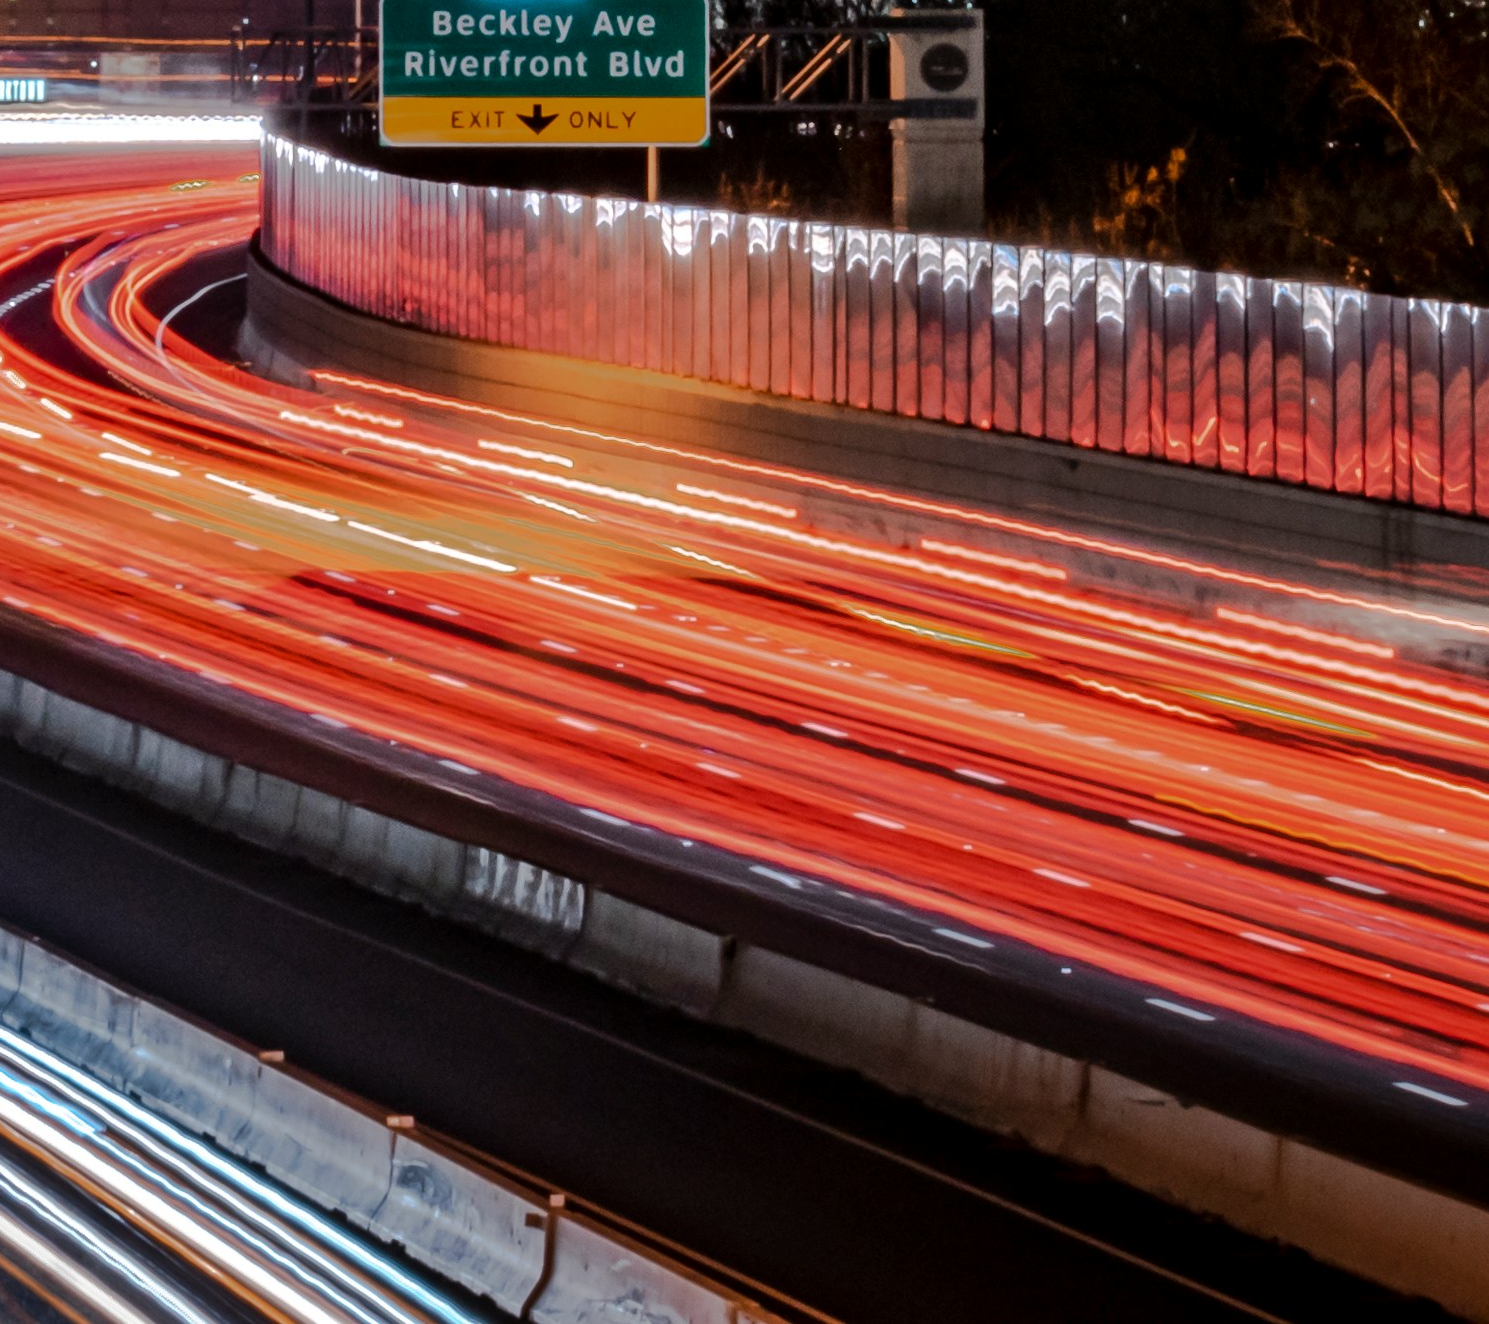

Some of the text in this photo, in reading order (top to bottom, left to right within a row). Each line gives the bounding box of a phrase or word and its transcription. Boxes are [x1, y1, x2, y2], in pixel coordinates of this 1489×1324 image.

[433, 9, 656, 44] Beckley Ave
[405, 49, 685, 77] Riverfront Blvd
[451, 110, 637, 128] EXIT ONLY
